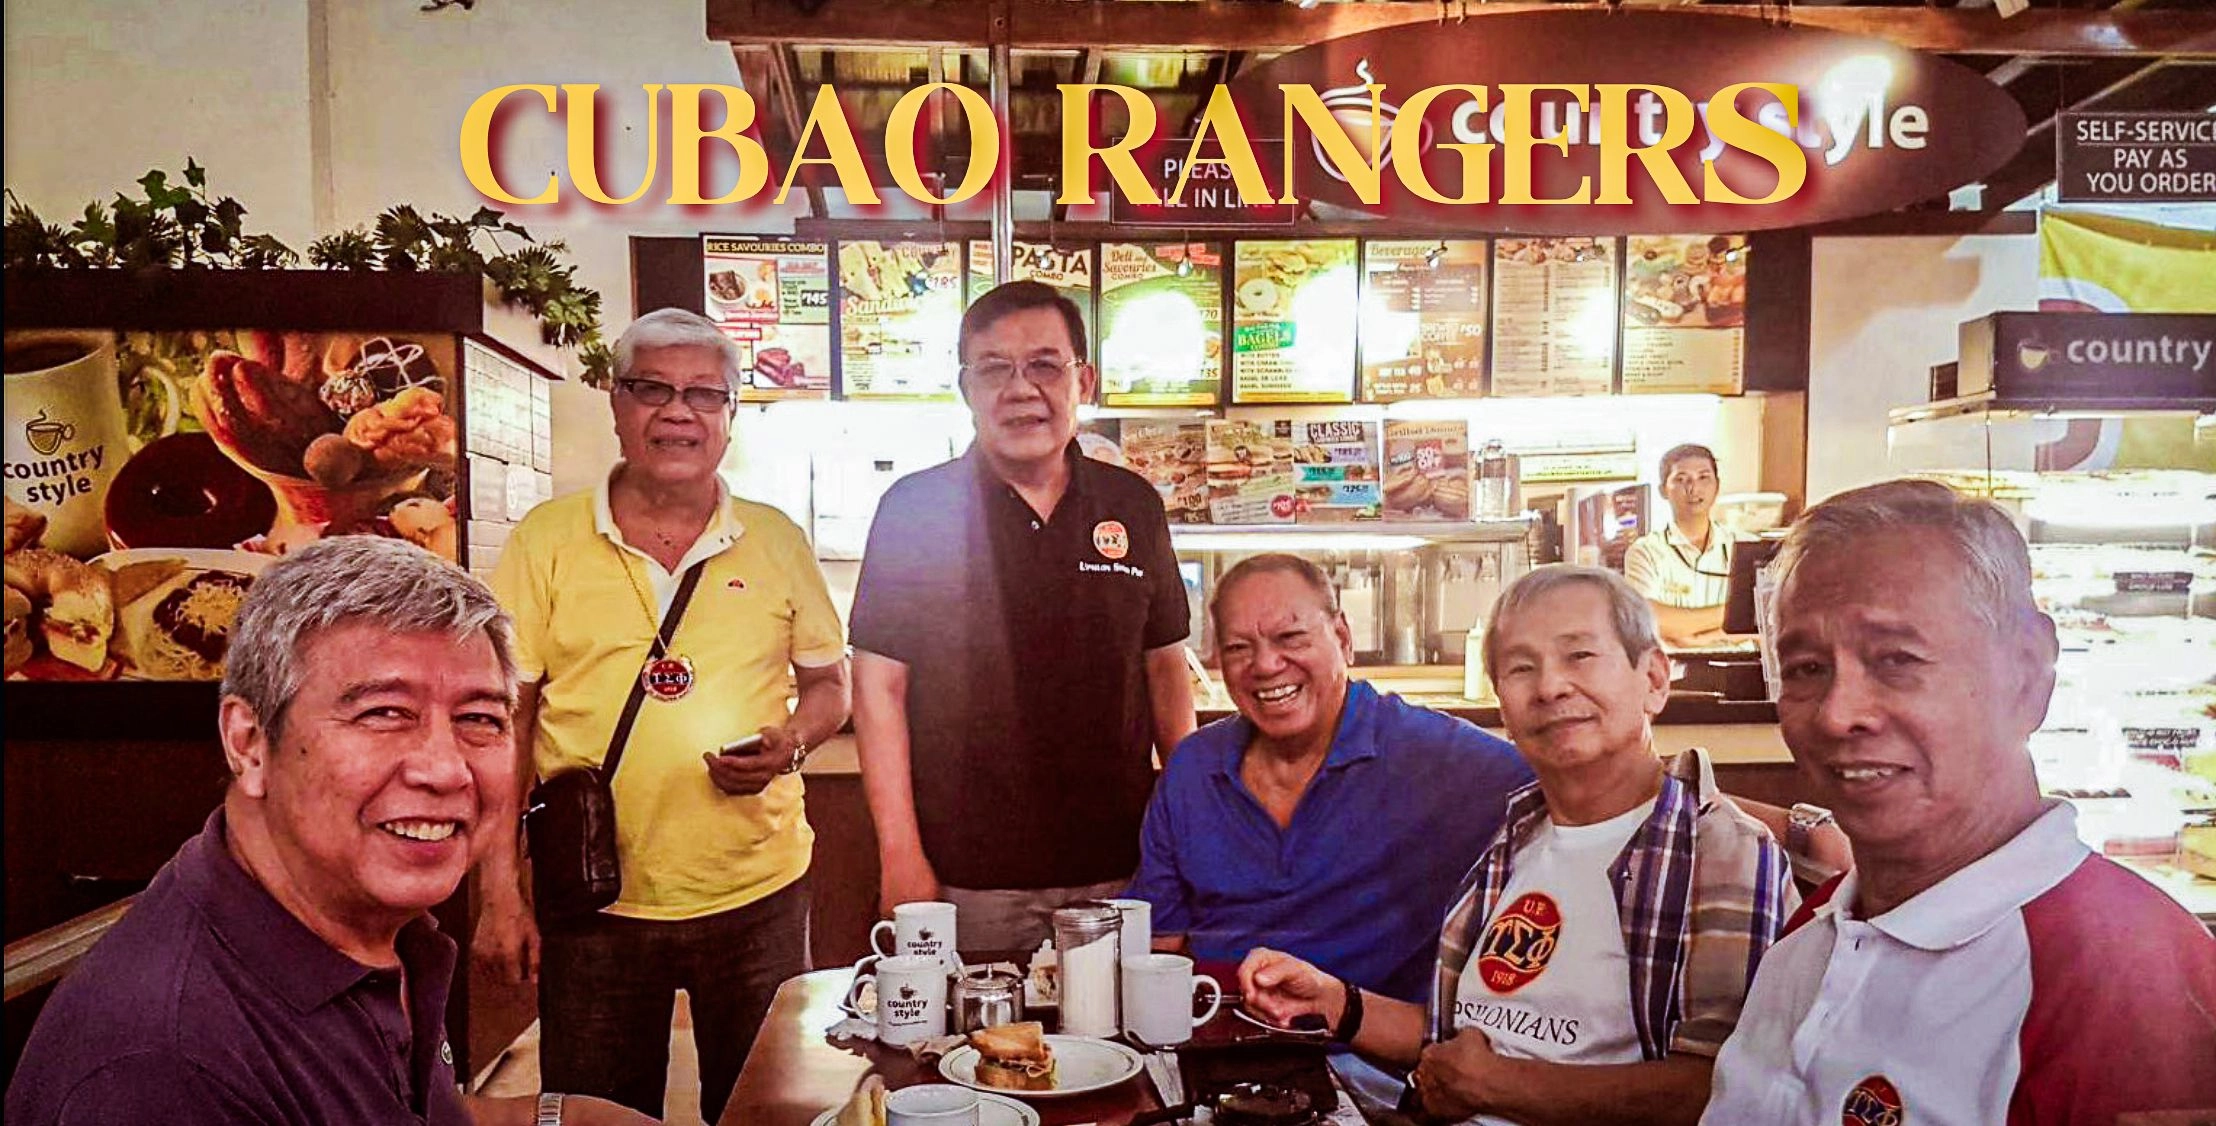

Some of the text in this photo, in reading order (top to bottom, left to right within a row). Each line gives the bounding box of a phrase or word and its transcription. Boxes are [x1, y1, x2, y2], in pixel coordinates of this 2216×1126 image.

[1164, 158, 1233, 180] PLEAS
[2113, 148, 2188, 169] PAY AS
[2086, 172, 2133, 193] YOU
[1194, 188, 1218, 208] IN
[1013, 245, 1087, 276] PASTA
[2066, 335, 2212, 371] country
[1310, 421, 1361, 440] CLASSIC
[4, 445, 104, 479] country
[26, 474, 93, 506] style
[907, 940, 943, 949] country
[887, 999, 929, 1009] country
[894, 1008, 921, 1020] style
